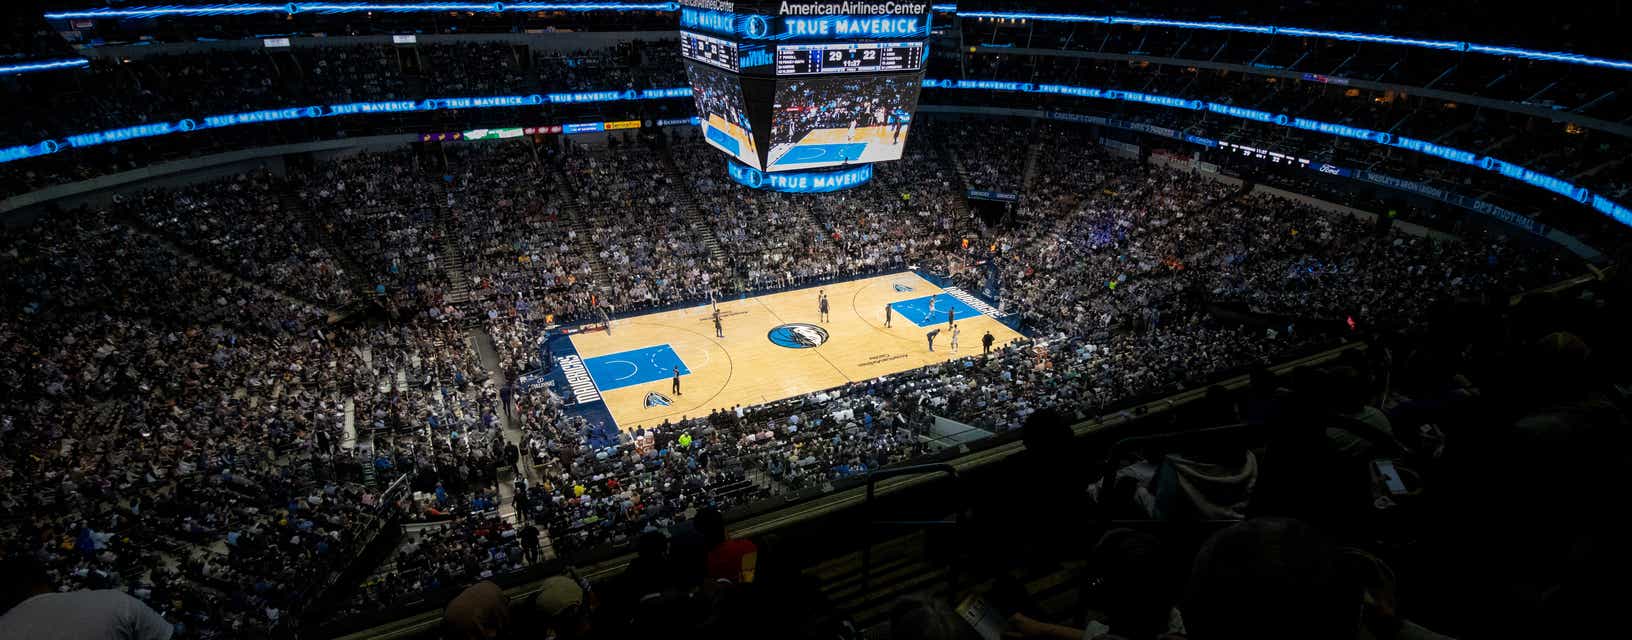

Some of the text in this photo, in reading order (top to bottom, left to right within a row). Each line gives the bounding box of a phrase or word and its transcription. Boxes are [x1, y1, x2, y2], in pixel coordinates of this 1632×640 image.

[780, 1, 926, 16] AmericanAirlinesCenter
[785, 17, 918, 35] TRUE MAVERICK
[829, 51, 843, 61] 29
[863, 50, 876, 60] 22
[958, 79, 1017, 91] TRUE MAVERICK
[1039, 84, 1100, 98] TRUE MAVERICK
[549, 91, 619, 102] TRUE MAVERICK
[643, 90, 664, 98] TRUE
[1123, 91, 1185, 107] TRUE MAVERICK
[331, 101, 416, 114] TRUE MAVERICK
[446, 96, 522, 108] TRUE MAVERICK
[205, 108, 299, 128] TRUE MAVERICK
[1208, 102, 1271, 122] TRUE MAVERICK
[68, 122, 170, 147] TRUE MAVERICK
[1295, 118, 1369, 141] TRUE MAVERICK
[1398, 136, 1475, 164] TRUE MAVERICK
[1319, 162, 1340, 174] Ford
[771, 174, 807, 189] TRUE
[1499, 160, 1574, 194] TRUE MAVERICK
[1593, 194, 1614, 215] TRUE
[557, 354, 600, 404] MAVERICKS
